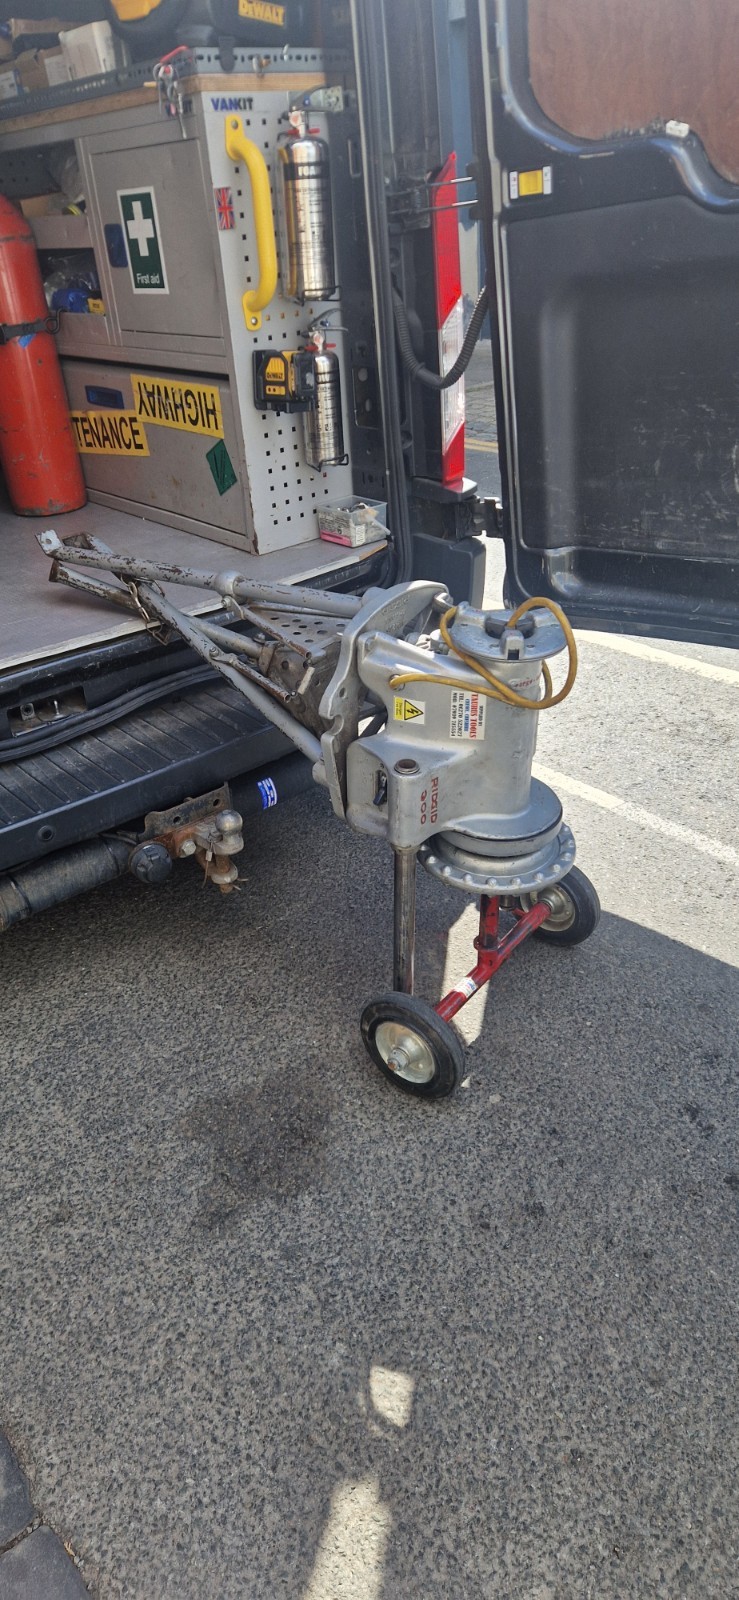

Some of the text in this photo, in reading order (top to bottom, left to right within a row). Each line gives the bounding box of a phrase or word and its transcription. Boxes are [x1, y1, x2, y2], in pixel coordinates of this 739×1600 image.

[211, 97, 253, 111] VANKIT
[136, 273, 160, 284] First aid
[137, 382, 219, 431] HIGHWAY
[431, 777, 439, 823] RIDGID
